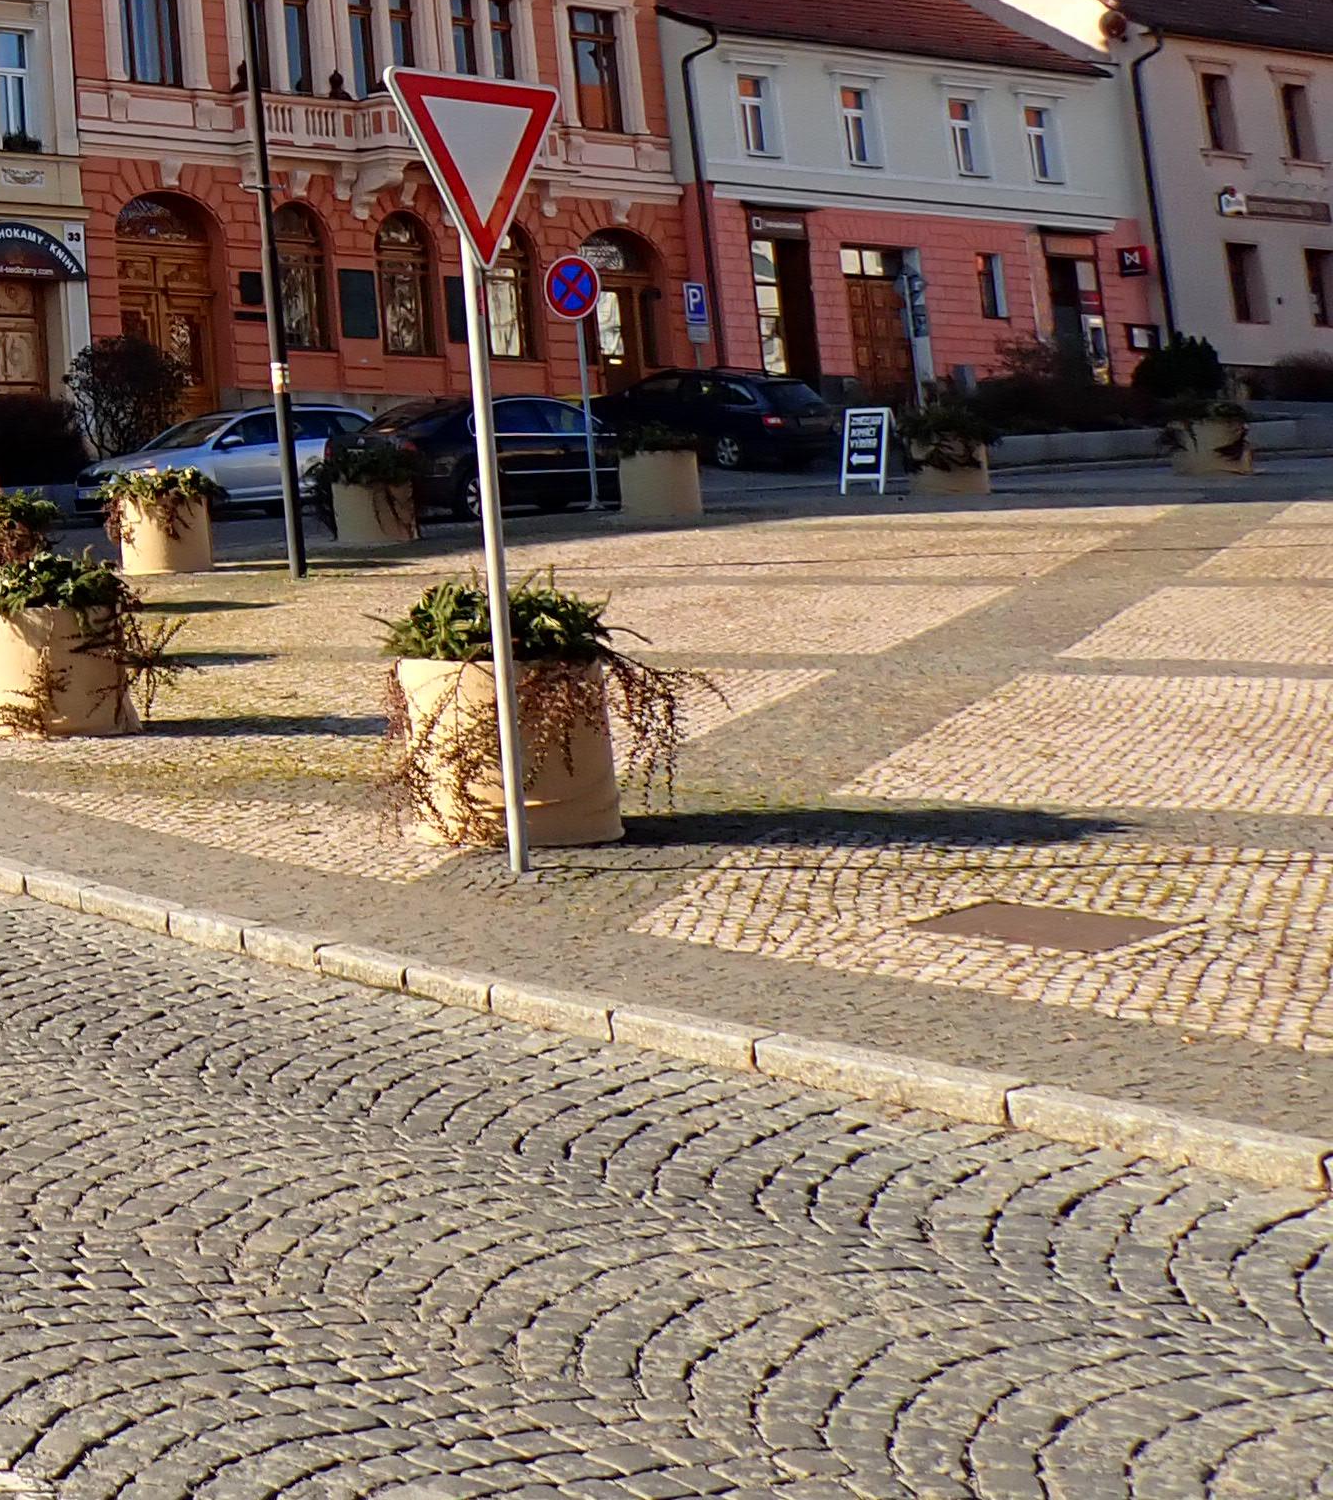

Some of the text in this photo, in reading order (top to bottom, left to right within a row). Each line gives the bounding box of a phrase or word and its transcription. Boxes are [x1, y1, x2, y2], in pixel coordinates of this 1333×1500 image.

[67, 232, 81, 242] 33
[49, 243, 81, 275] KNIHY
[688, 288, 701, 312] P
